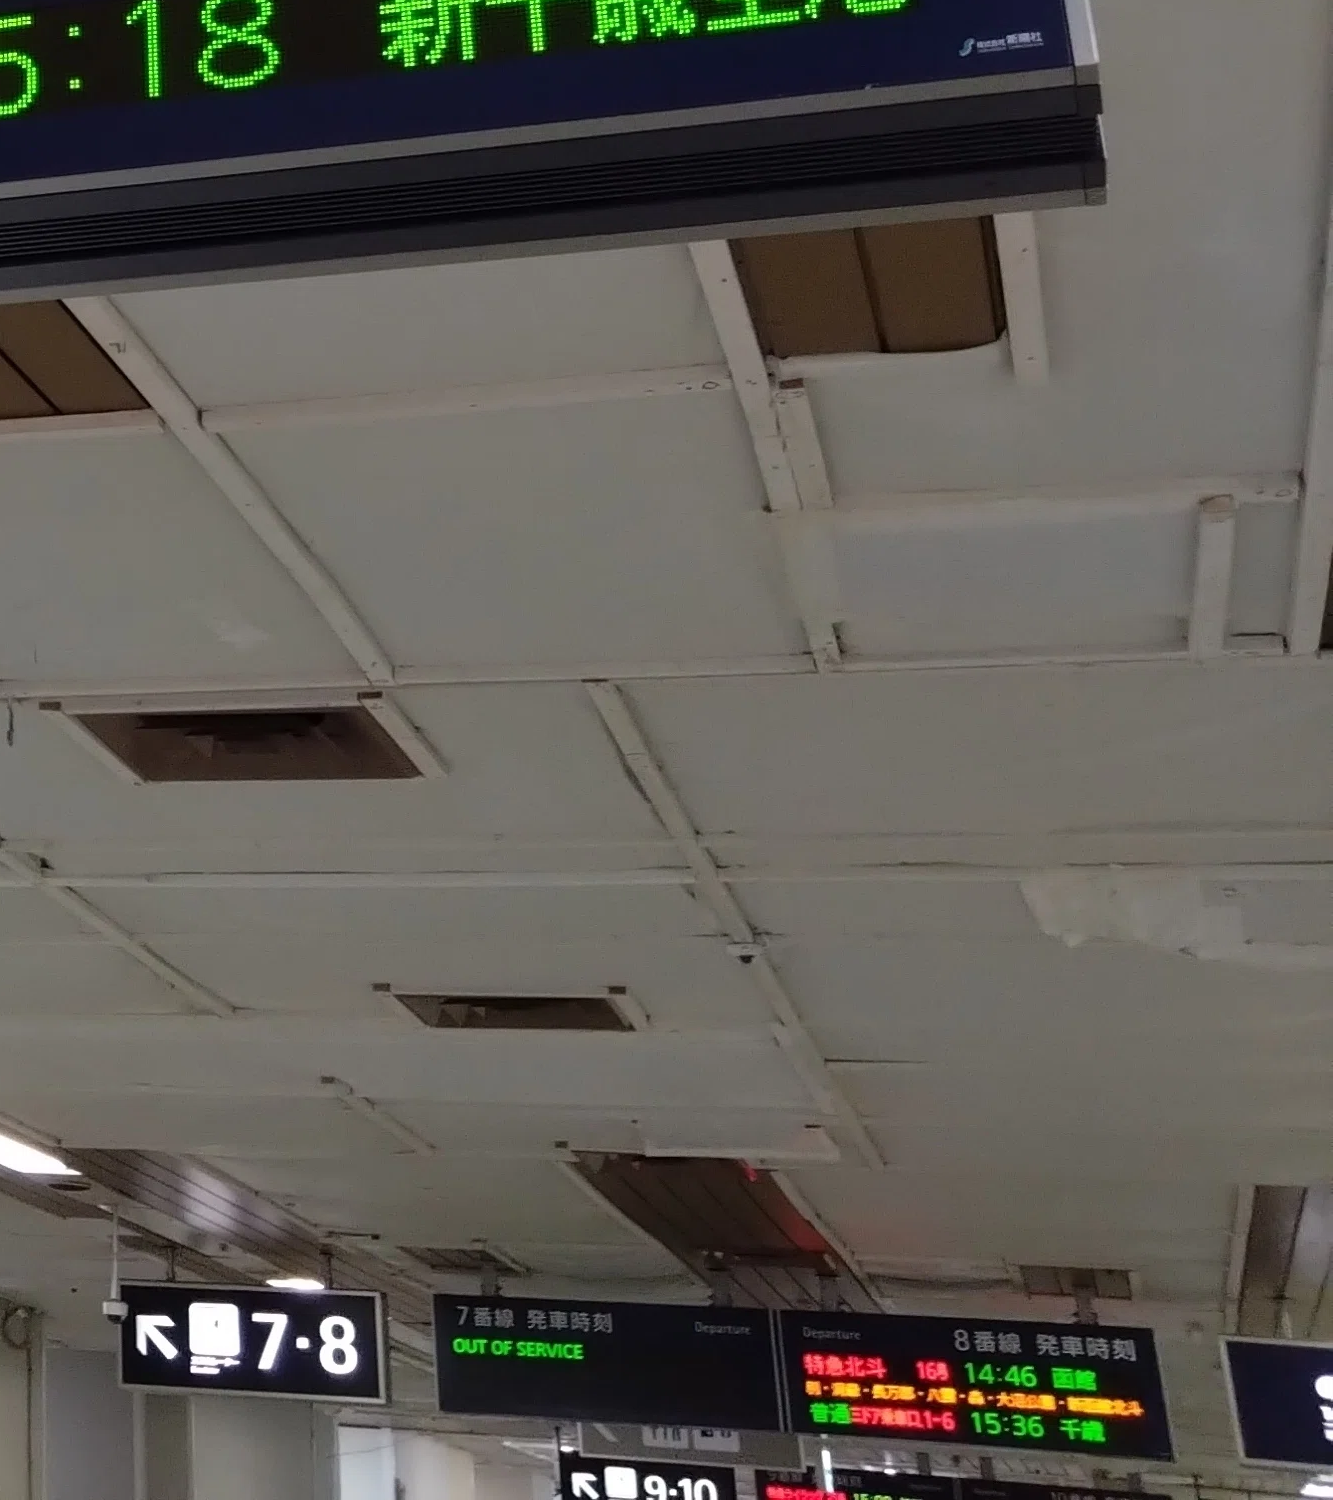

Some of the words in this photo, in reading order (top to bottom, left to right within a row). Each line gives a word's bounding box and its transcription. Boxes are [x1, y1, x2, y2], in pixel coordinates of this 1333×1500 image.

[456, 1306, 515, 1329] 7番線
[526, 1308, 613, 1333] 発車時刻
[694, 1321, 752, 1336] Departure
[803, 1326, 862, 1341] Departure
[953, 1328, 1023, 1354] 8番線
[1036, 1333, 1138, 1362] 発車時刻
[452, 1337, 489, 1355] OUT
[490, 1339, 514, 1356] OF
[515, 1340, 585, 1360] SERVICE
[802, 1353, 888, 1380] 特急北斗
[965, 1362, 1038, 1388] 14:46
[971, 1411, 1045, 1438] 15:36
[1059, 1418, 1106, 1443] 千歳
